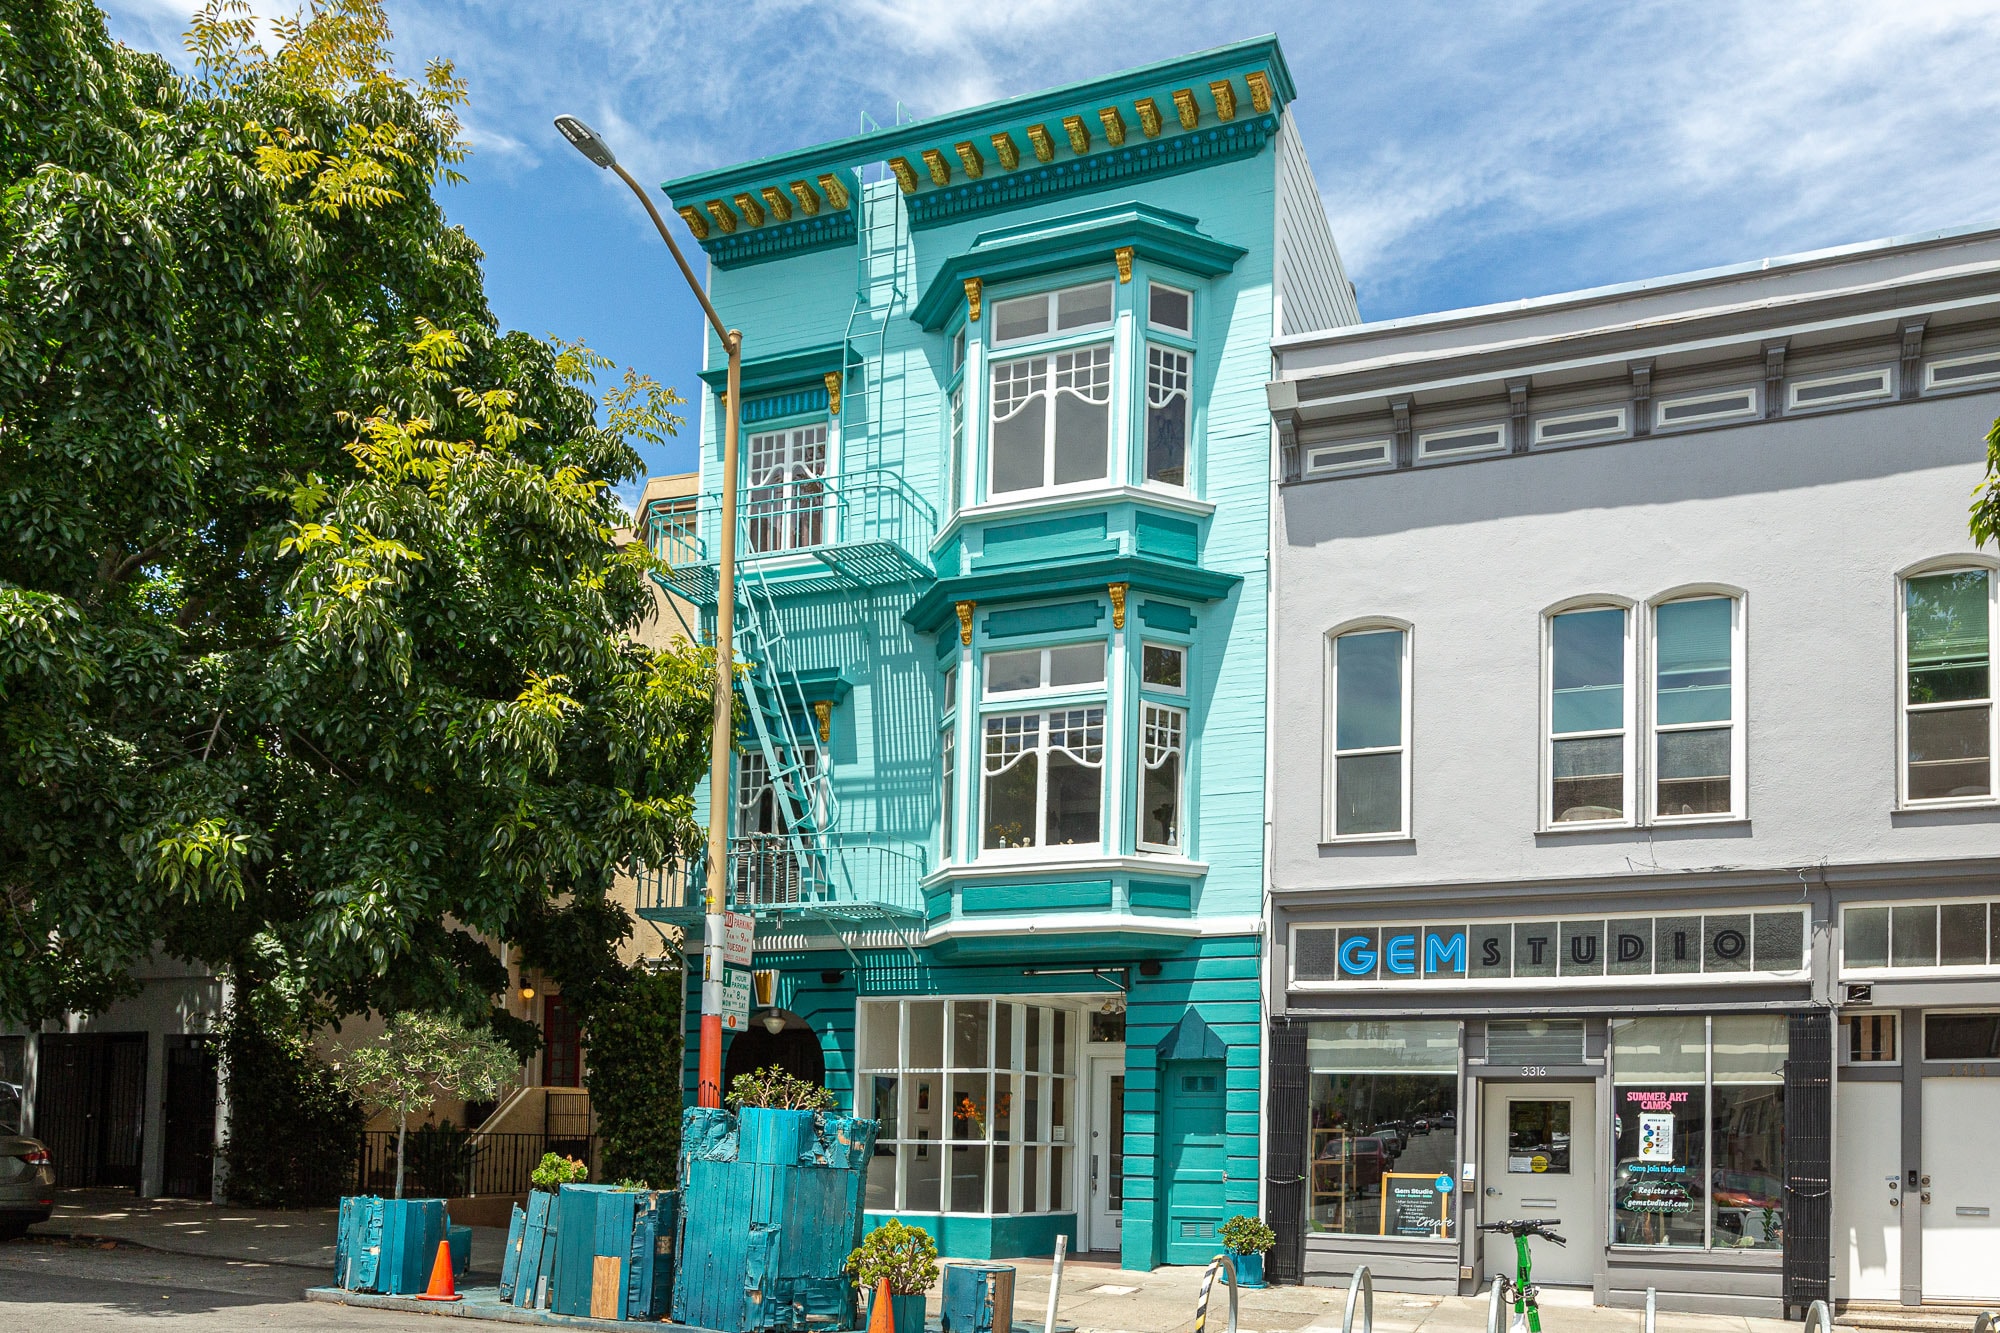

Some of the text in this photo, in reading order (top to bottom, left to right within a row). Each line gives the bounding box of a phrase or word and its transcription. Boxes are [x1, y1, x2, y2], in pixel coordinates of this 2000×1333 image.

[734, 918, 752, 930] PARKING
[726, 942, 747, 953] TUESDAY
[1338, 930, 1746, 975] GEM STUDIO
[732, 982, 750, 990] PARKING
[1522, 1066, 1546, 1076] 3316
[1627, 1092, 1688, 1102] SUMMER ART
[1641, 1101, 1672, 1110] CAMPS
[1638, 1187, 1668, 1196] Register
[1417, 1217, 1454, 1227] Create
